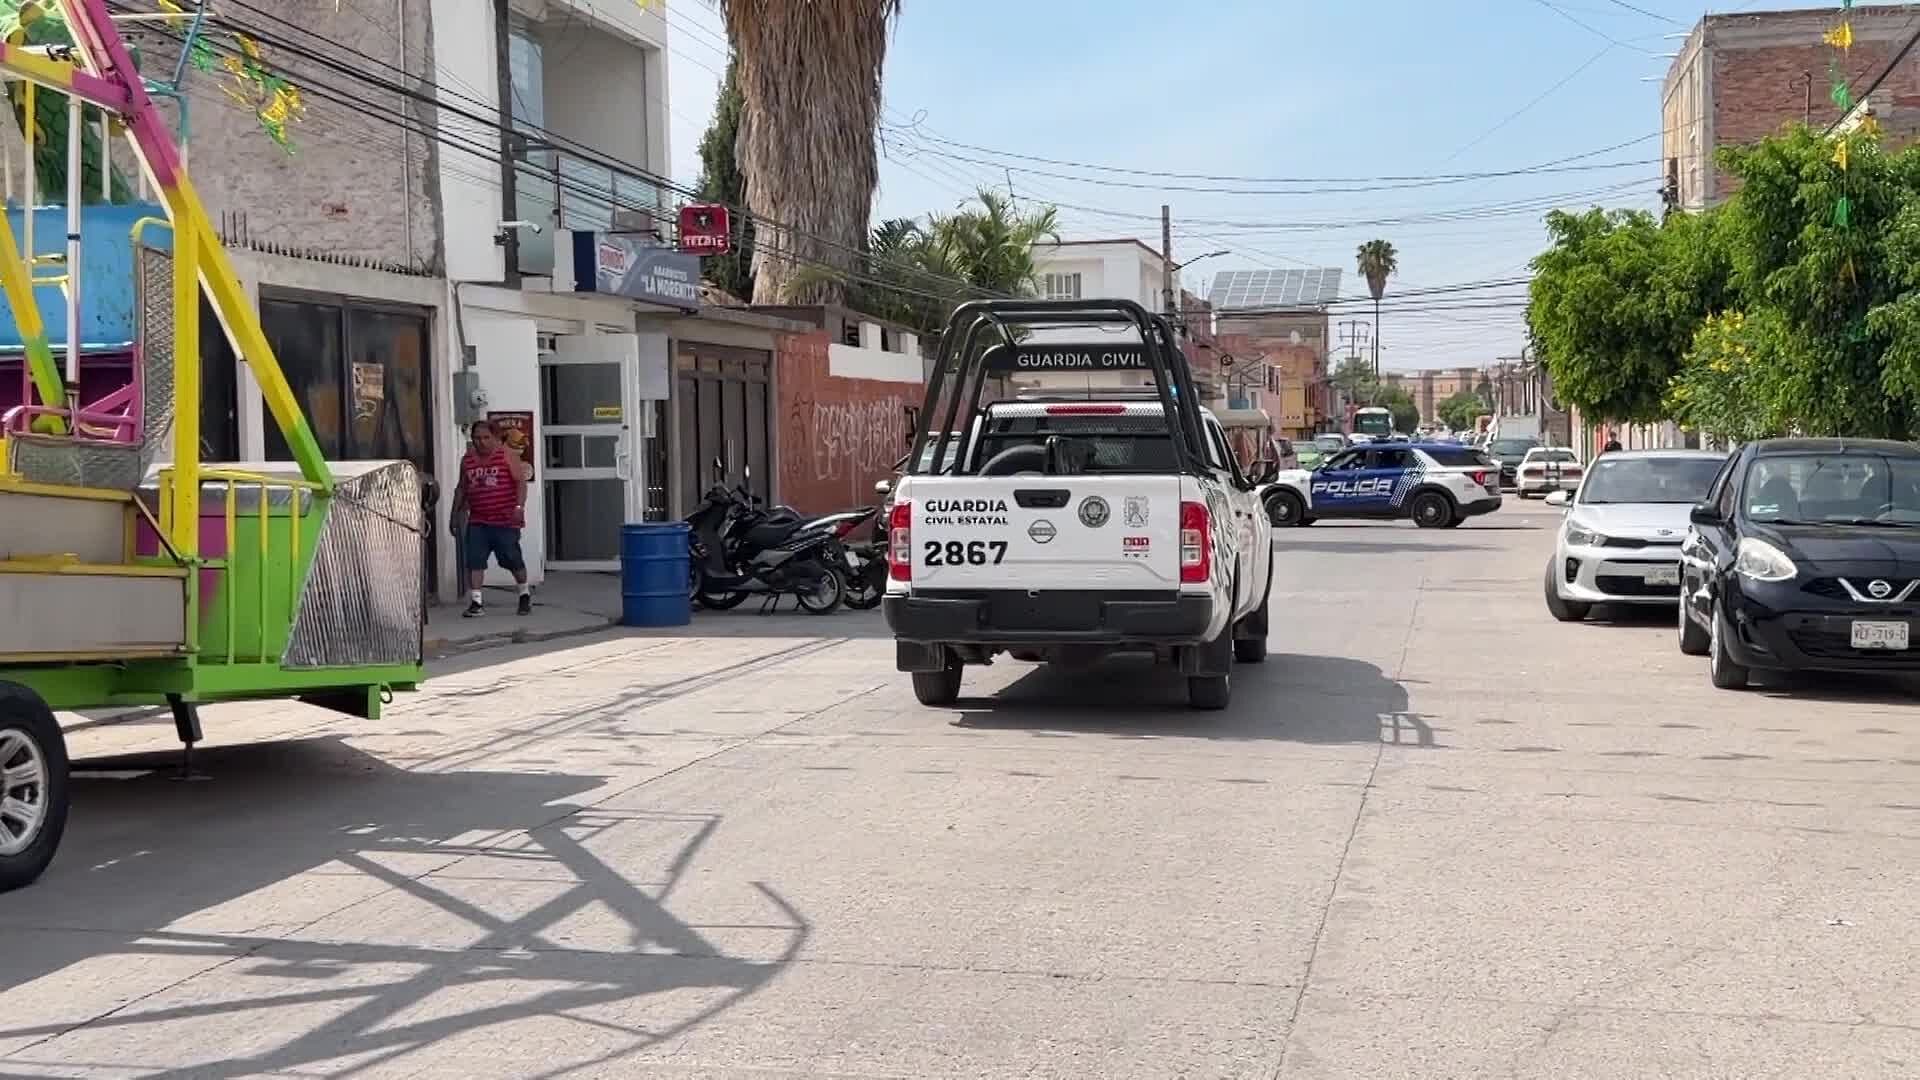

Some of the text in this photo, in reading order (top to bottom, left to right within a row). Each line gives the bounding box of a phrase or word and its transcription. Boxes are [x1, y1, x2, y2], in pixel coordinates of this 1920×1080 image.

[1017, 353, 1146, 367] GUARDIA CIVIL
[925, 500, 1009, 512] GUARDIA
[925, 517, 1009, 525] CIVIL ESTATAL
[924, 541, 1009, 566] 2867
